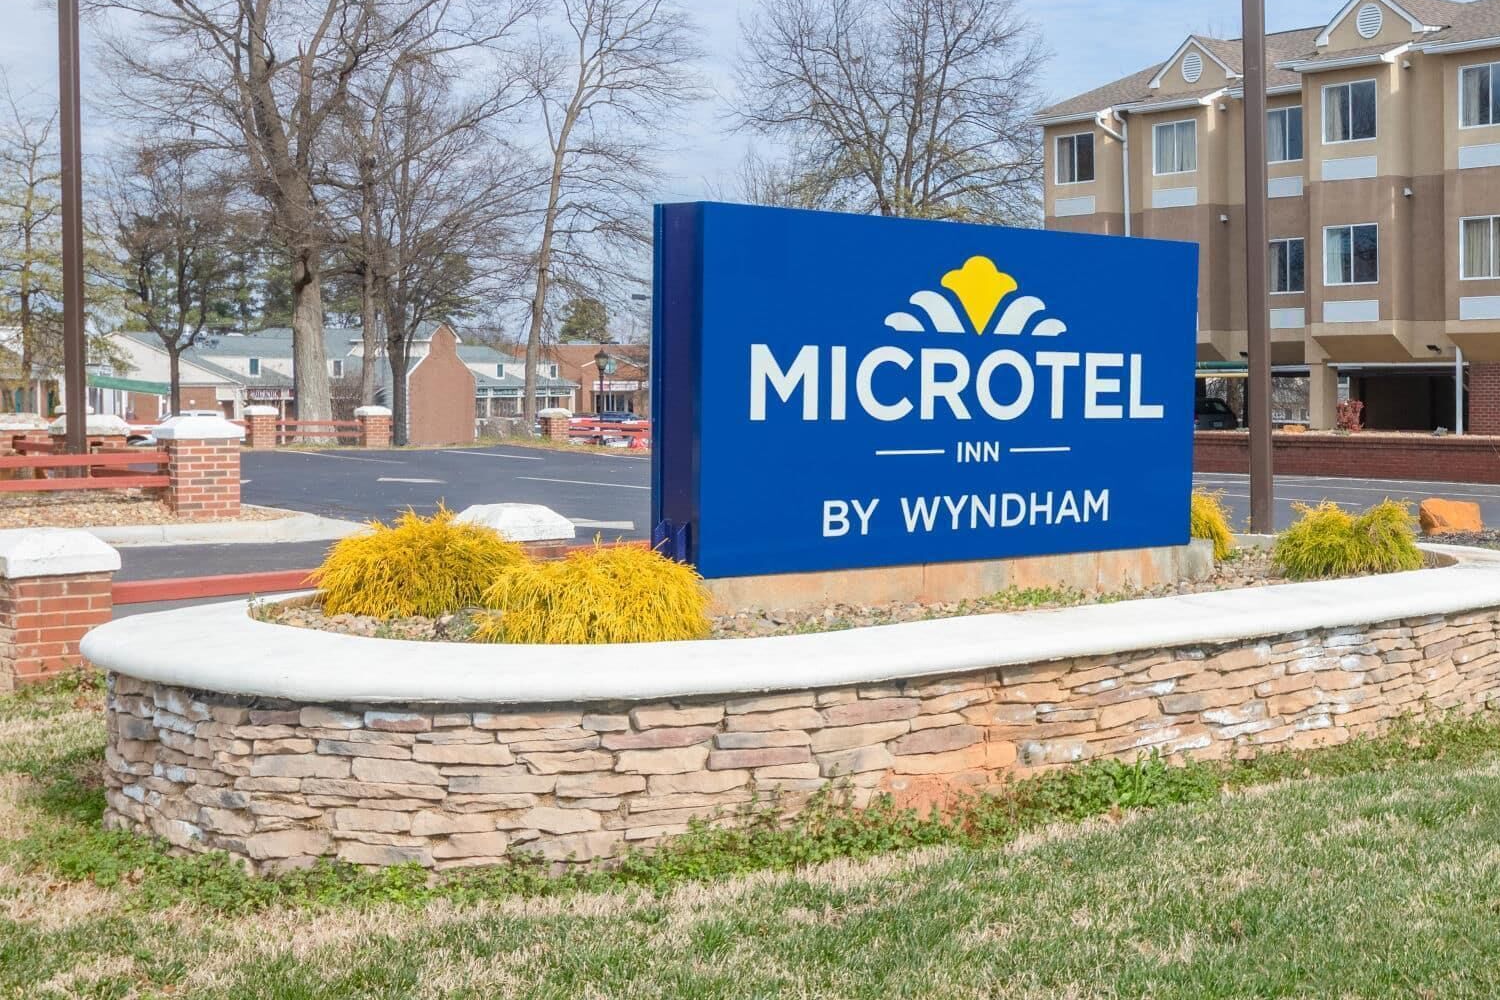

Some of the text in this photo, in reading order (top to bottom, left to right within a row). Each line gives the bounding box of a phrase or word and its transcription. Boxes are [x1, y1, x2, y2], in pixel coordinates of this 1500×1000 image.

[749, 343, 1165, 421] MICROTEL
[957, 441, 1000, 463] INN
[822, 490, 1110, 537] BY WYNDHAM
